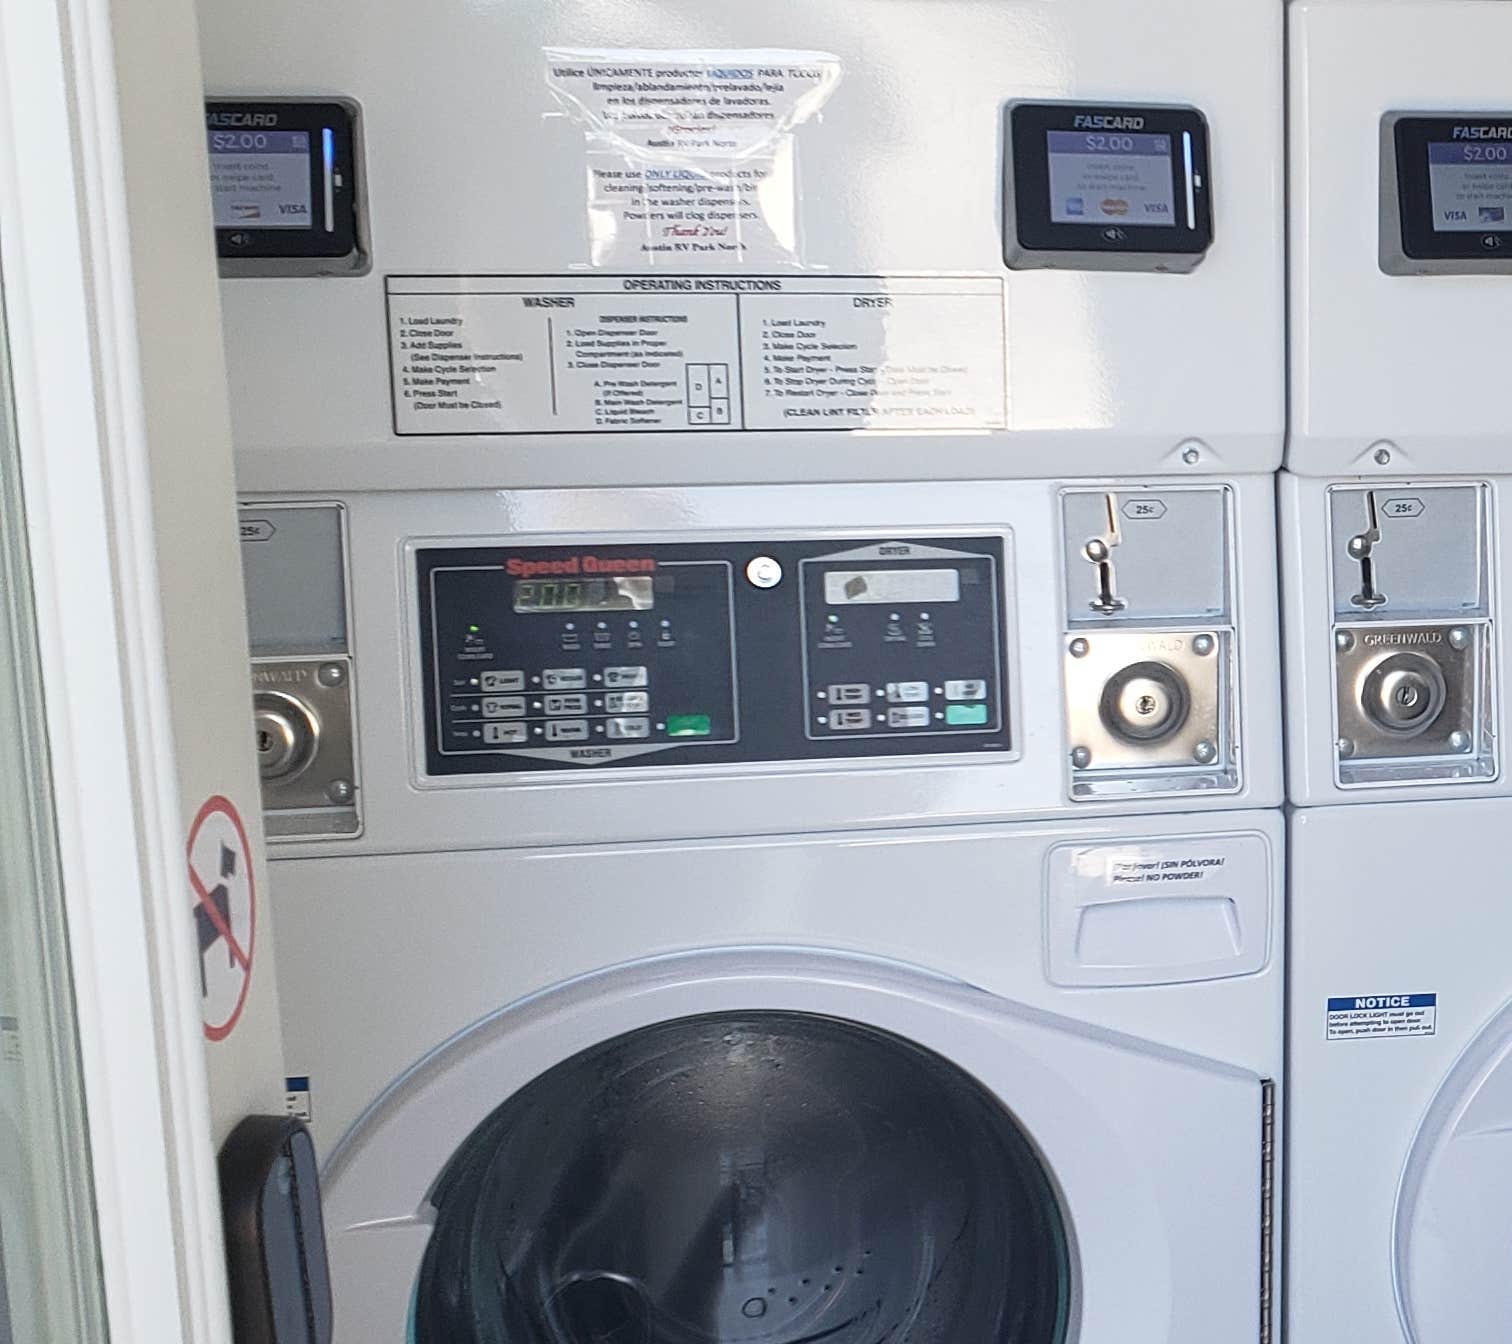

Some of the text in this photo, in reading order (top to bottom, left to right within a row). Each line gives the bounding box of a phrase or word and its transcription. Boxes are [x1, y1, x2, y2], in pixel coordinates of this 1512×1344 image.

[553, 69, 584, 78] Utilice
[758, 69, 783, 78] PARA
[206, 113, 277, 126] ASCARD
[1074, 115, 1144, 129] FASCARD
[213, 135, 267, 149] $2.00
[1086, 136, 1134, 151] $2.00
[1464, 147, 1507, 161] $2.00
[625, 170, 641, 178] use
[661, 198, 695, 206] washer
[279, 204, 307, 214] VISA
[1144, 203, 1169, 213] VISA
[667, 211, 706, 220] will clog
[1444, 211, 1467, 221] VISA
[662, 224, 699, 237] Thank
[622, 279, 783, 291] OPERATING INSTRUCTIONS
[523, 296, 575, 308] WASHER
[1135, 504, 1157, 515] 25¢
[1395, 503, 1414, 514] 25¢
[507, 556, 656, 576] Speed Queen
[1362, 632, 1442, 646] GREENWALD
[569, 749, 612, 759] WASHER
[1180, 857, 1225, 867] PÓLVORA!
[1161, 872, 1204, 880] POWDER!
[1355, 996, 1410, 1008] NOTICE
[1349, 1019, 1382, 1027] attempting
[1355, 1027, 1371, 1035] push
